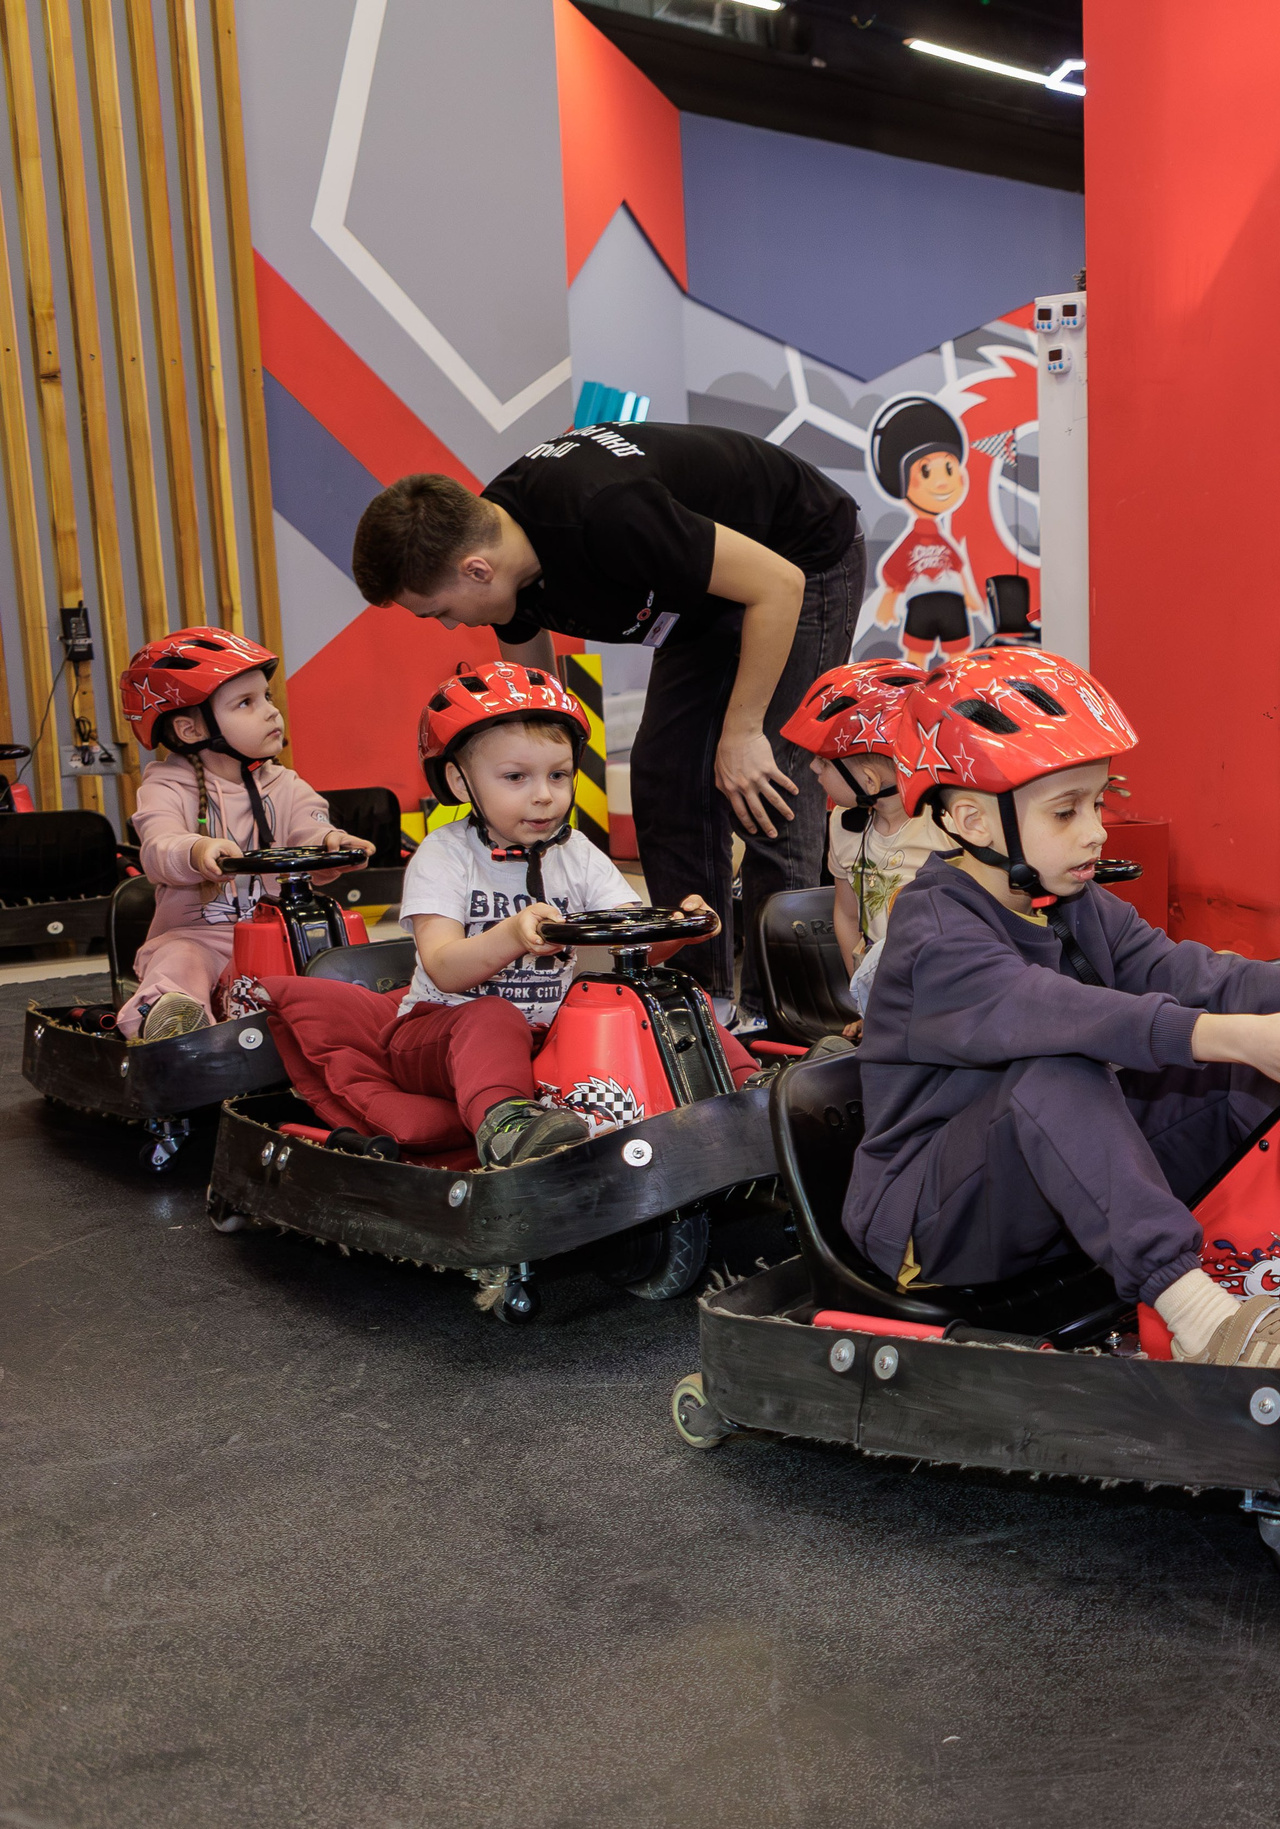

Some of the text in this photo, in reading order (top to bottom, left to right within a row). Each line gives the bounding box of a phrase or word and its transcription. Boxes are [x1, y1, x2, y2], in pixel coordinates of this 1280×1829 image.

[469, 889, 569, 918] BROX
[498, 986, 530, 999] YORK
[535, 986, 560, 998] CITY
